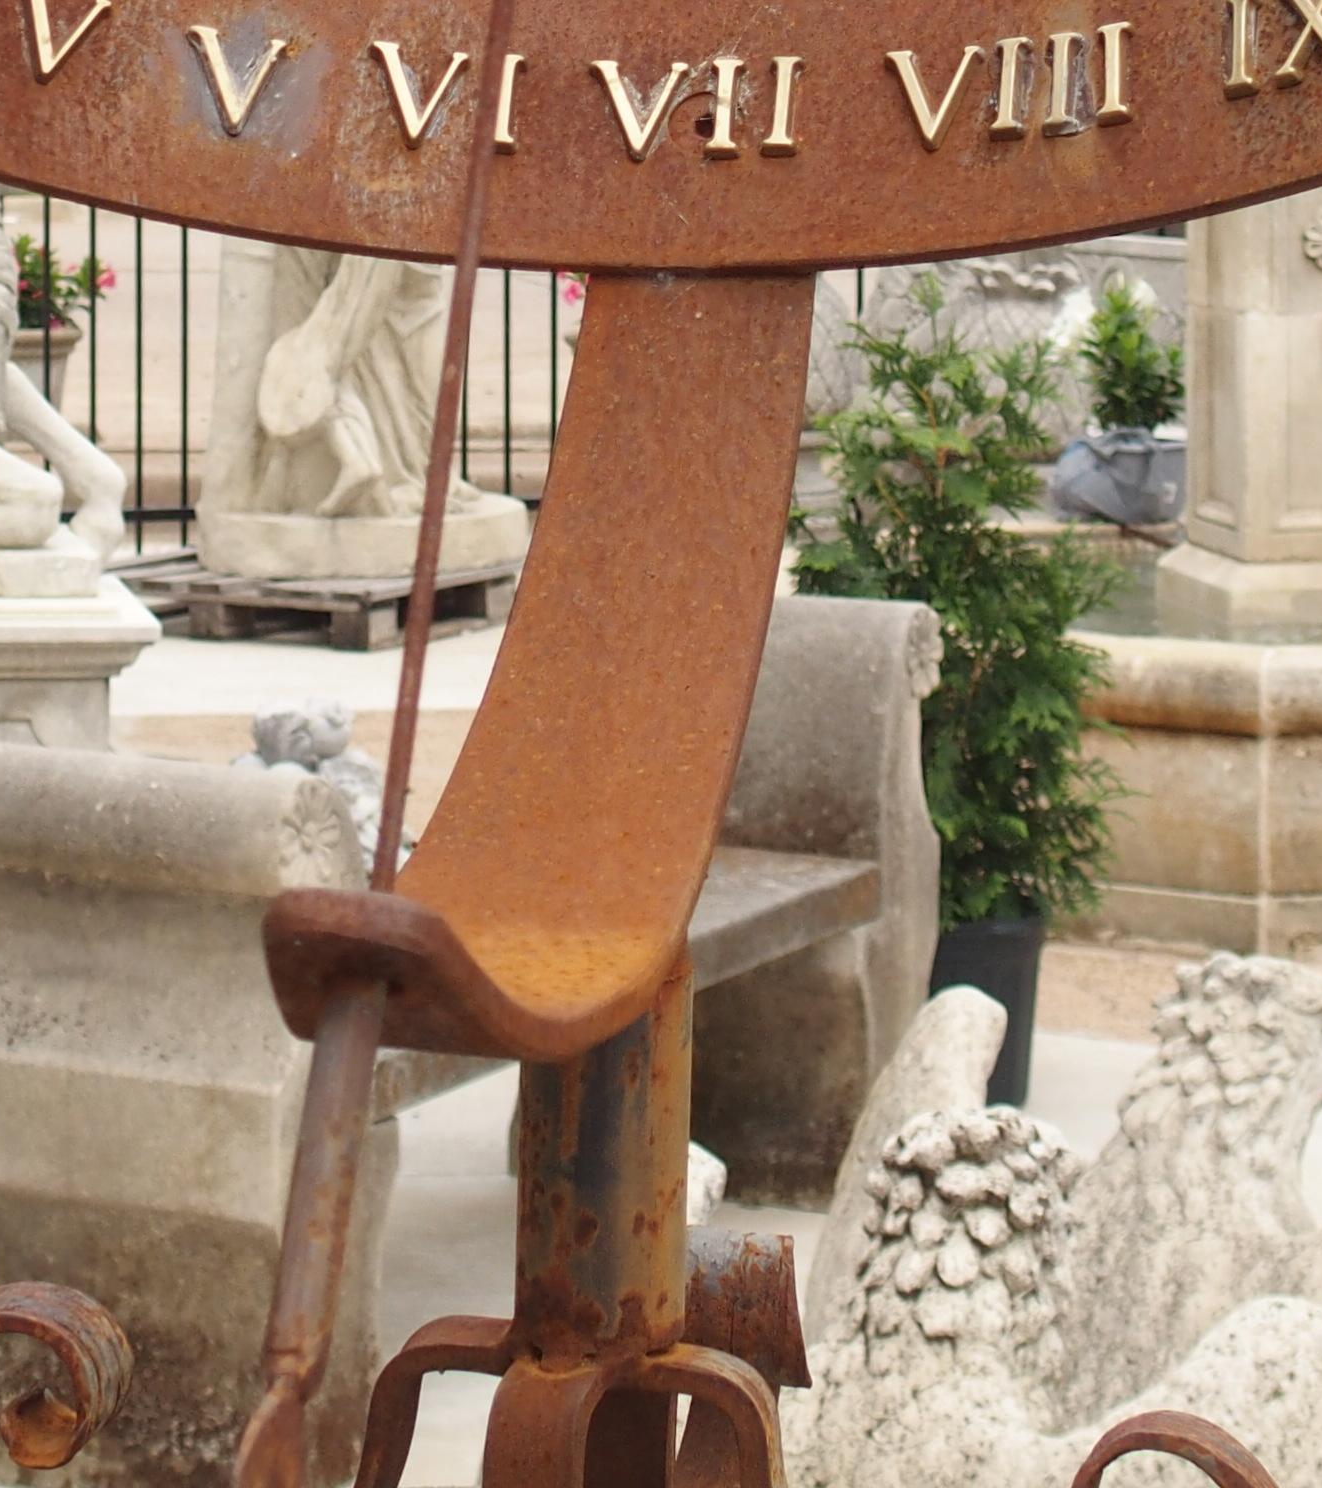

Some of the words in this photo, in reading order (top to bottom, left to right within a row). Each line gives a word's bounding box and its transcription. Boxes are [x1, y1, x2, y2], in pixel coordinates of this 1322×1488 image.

[186, 25, 286, 137] V
[371, 40, 526, 155] VI
[590, 55, 805, 162] VII
[884, 21, 1135, 151] VIII
